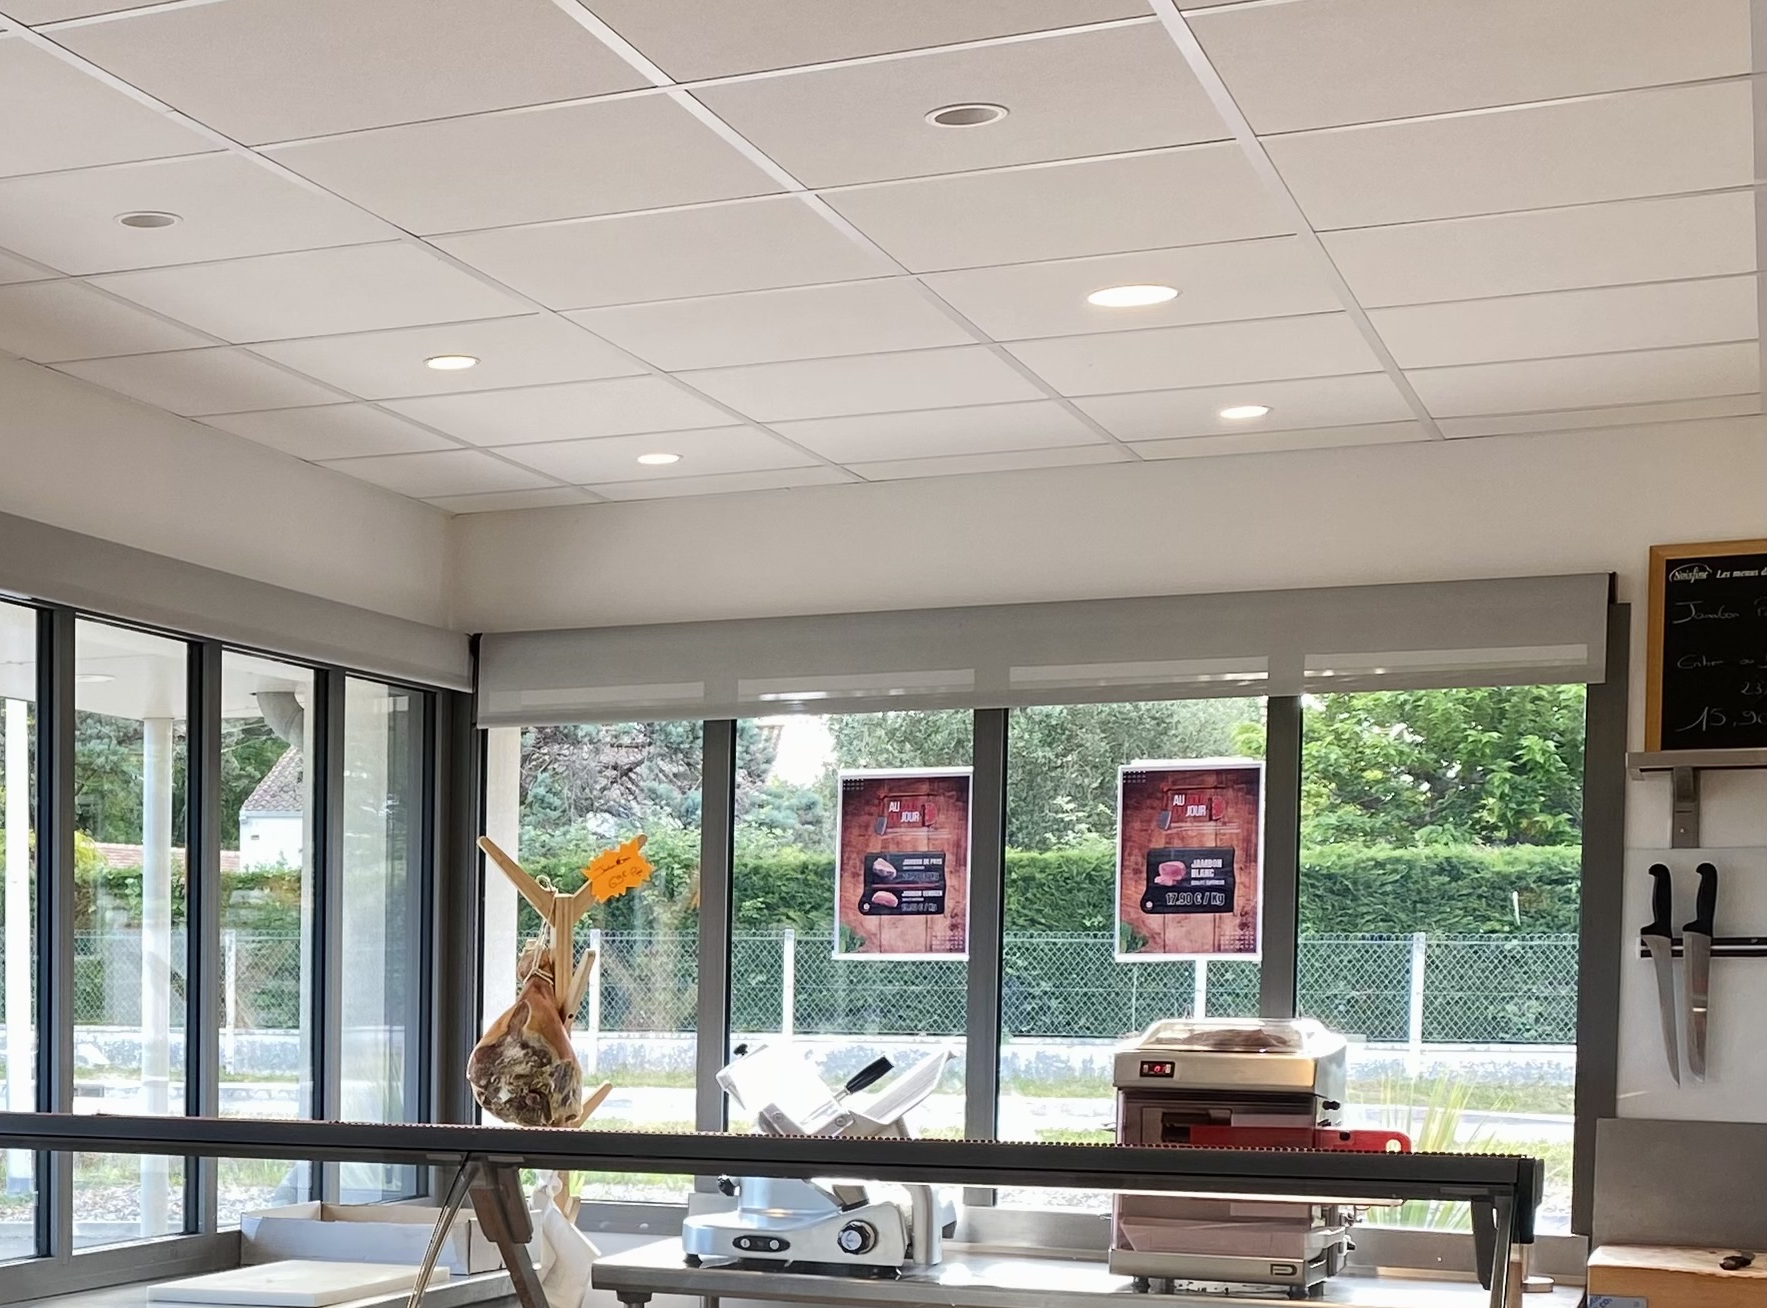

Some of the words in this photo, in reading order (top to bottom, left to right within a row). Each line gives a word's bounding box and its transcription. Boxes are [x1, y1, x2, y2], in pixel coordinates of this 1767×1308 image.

[1716, 570, 1731, 579] Les
[1672, 600, 1740, 624] Jambon
[1173, 794, 1185, 806] AU
[889, 801, 900, 812] AU
[1185, 804, 1206, 817] JOUR
[900, 811, 920, 823] JOUR
